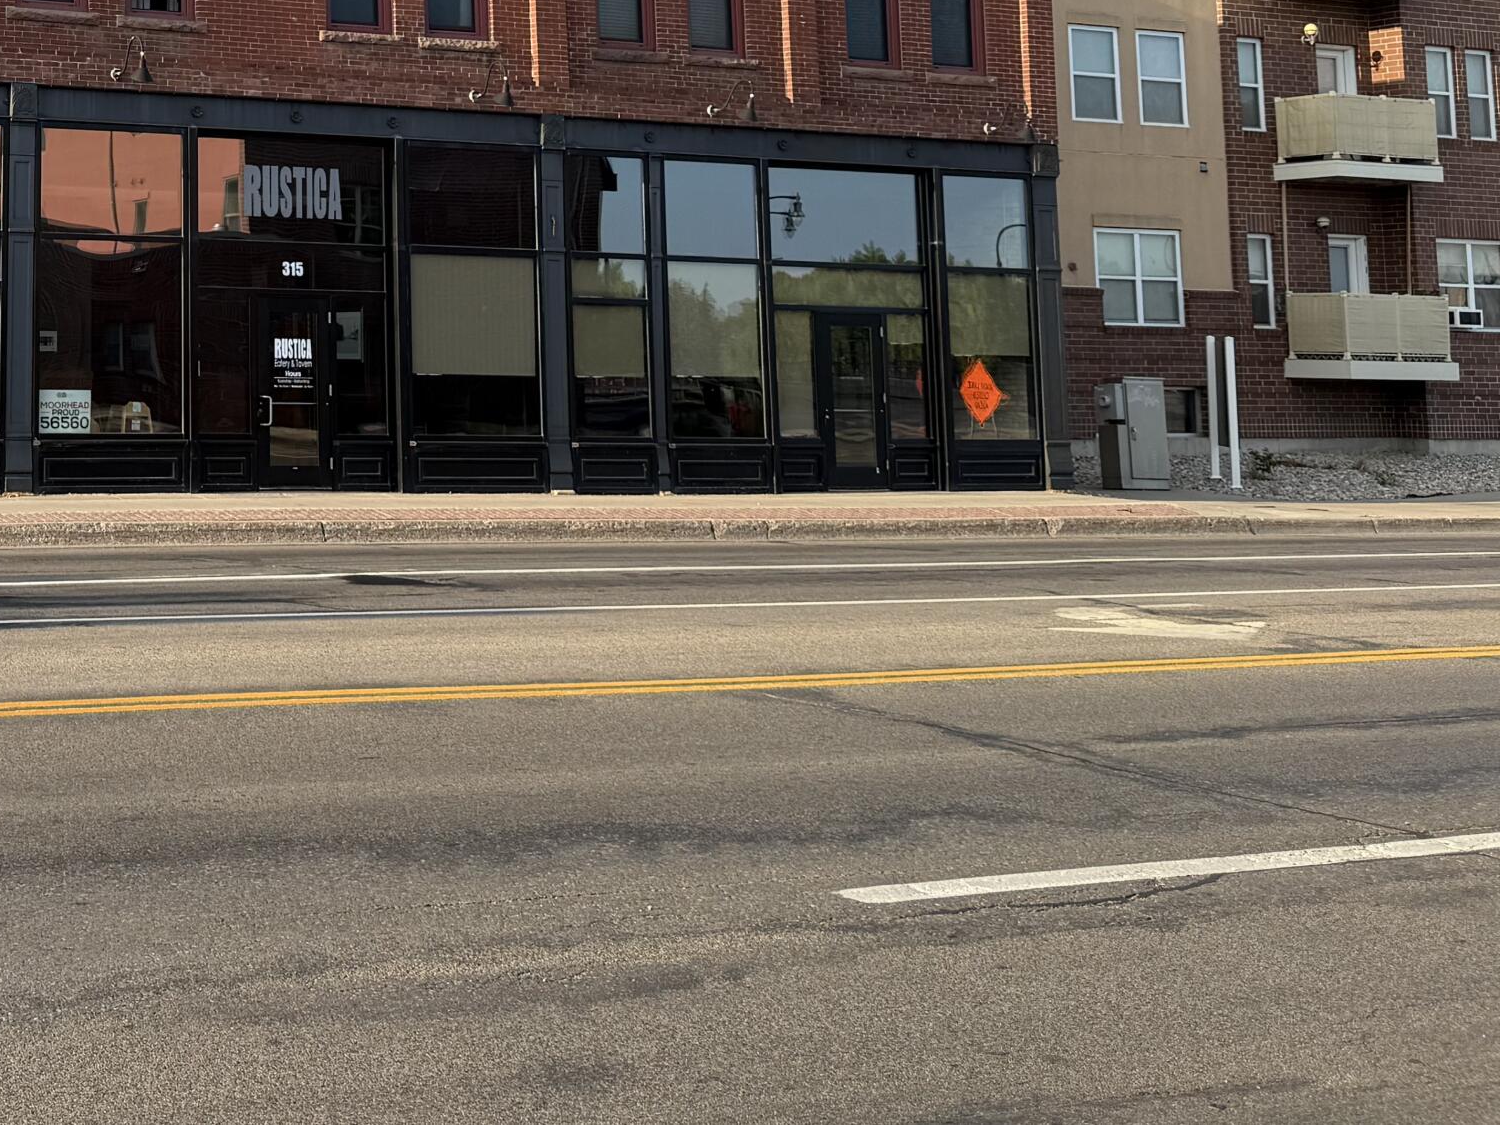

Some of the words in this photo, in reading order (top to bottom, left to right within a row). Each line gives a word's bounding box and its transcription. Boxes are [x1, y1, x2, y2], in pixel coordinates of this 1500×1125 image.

[243, 164, 343, 220] RUSTICA
[281, 261, 304, 277] 315
[274, 338, 312, 360] RUSTICA
[40, 401, 90, 409] MOORHEAD
[40, 416, 90, 429] 56560
